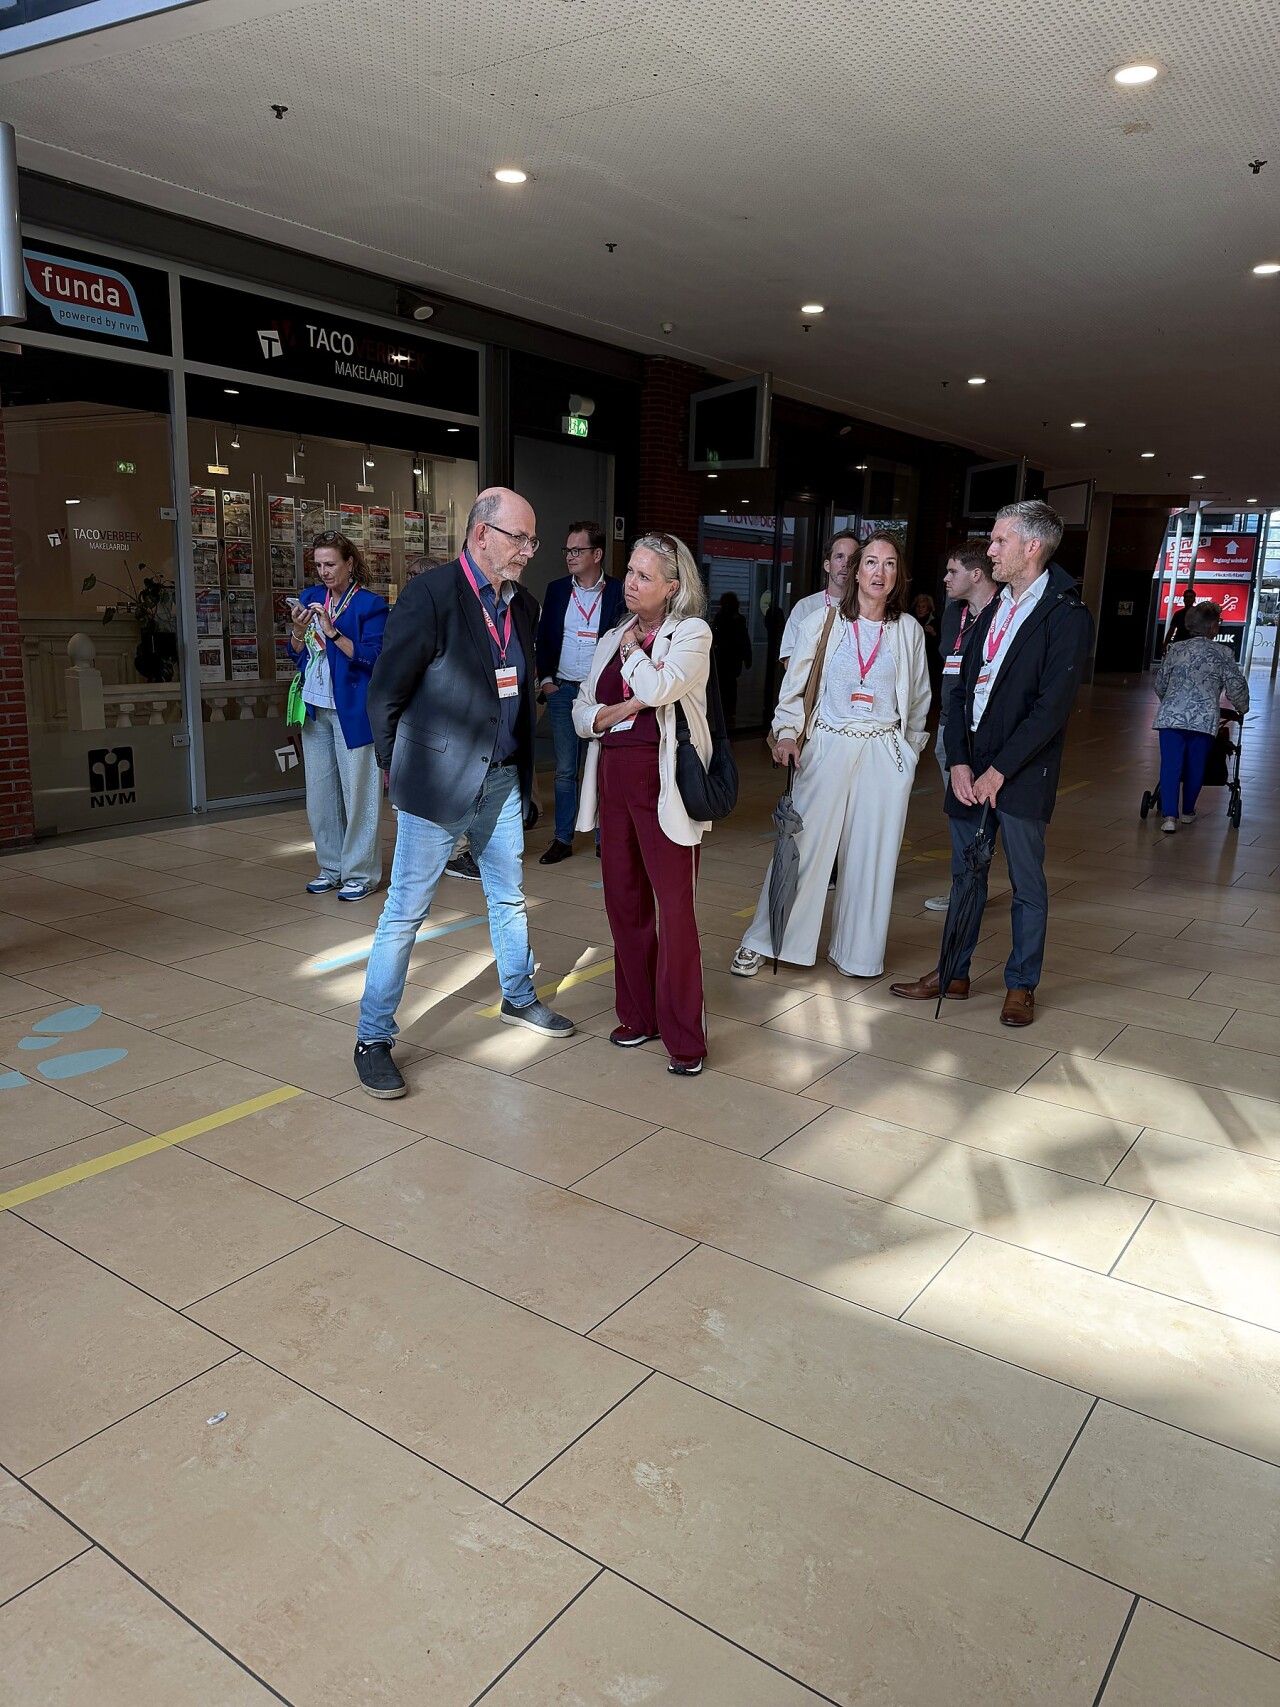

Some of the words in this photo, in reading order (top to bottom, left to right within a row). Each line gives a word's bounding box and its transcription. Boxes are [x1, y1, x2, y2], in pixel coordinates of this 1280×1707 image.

[41, 266, 120, 308] funda
[59, 309, 102, 325] powered
[105, 317, 117, 330] by
[119, 322, 140, 333] nvm
[335, 360, 404, 388] MAKELAARDIJ
[90, 791, 137, 809] NVM
